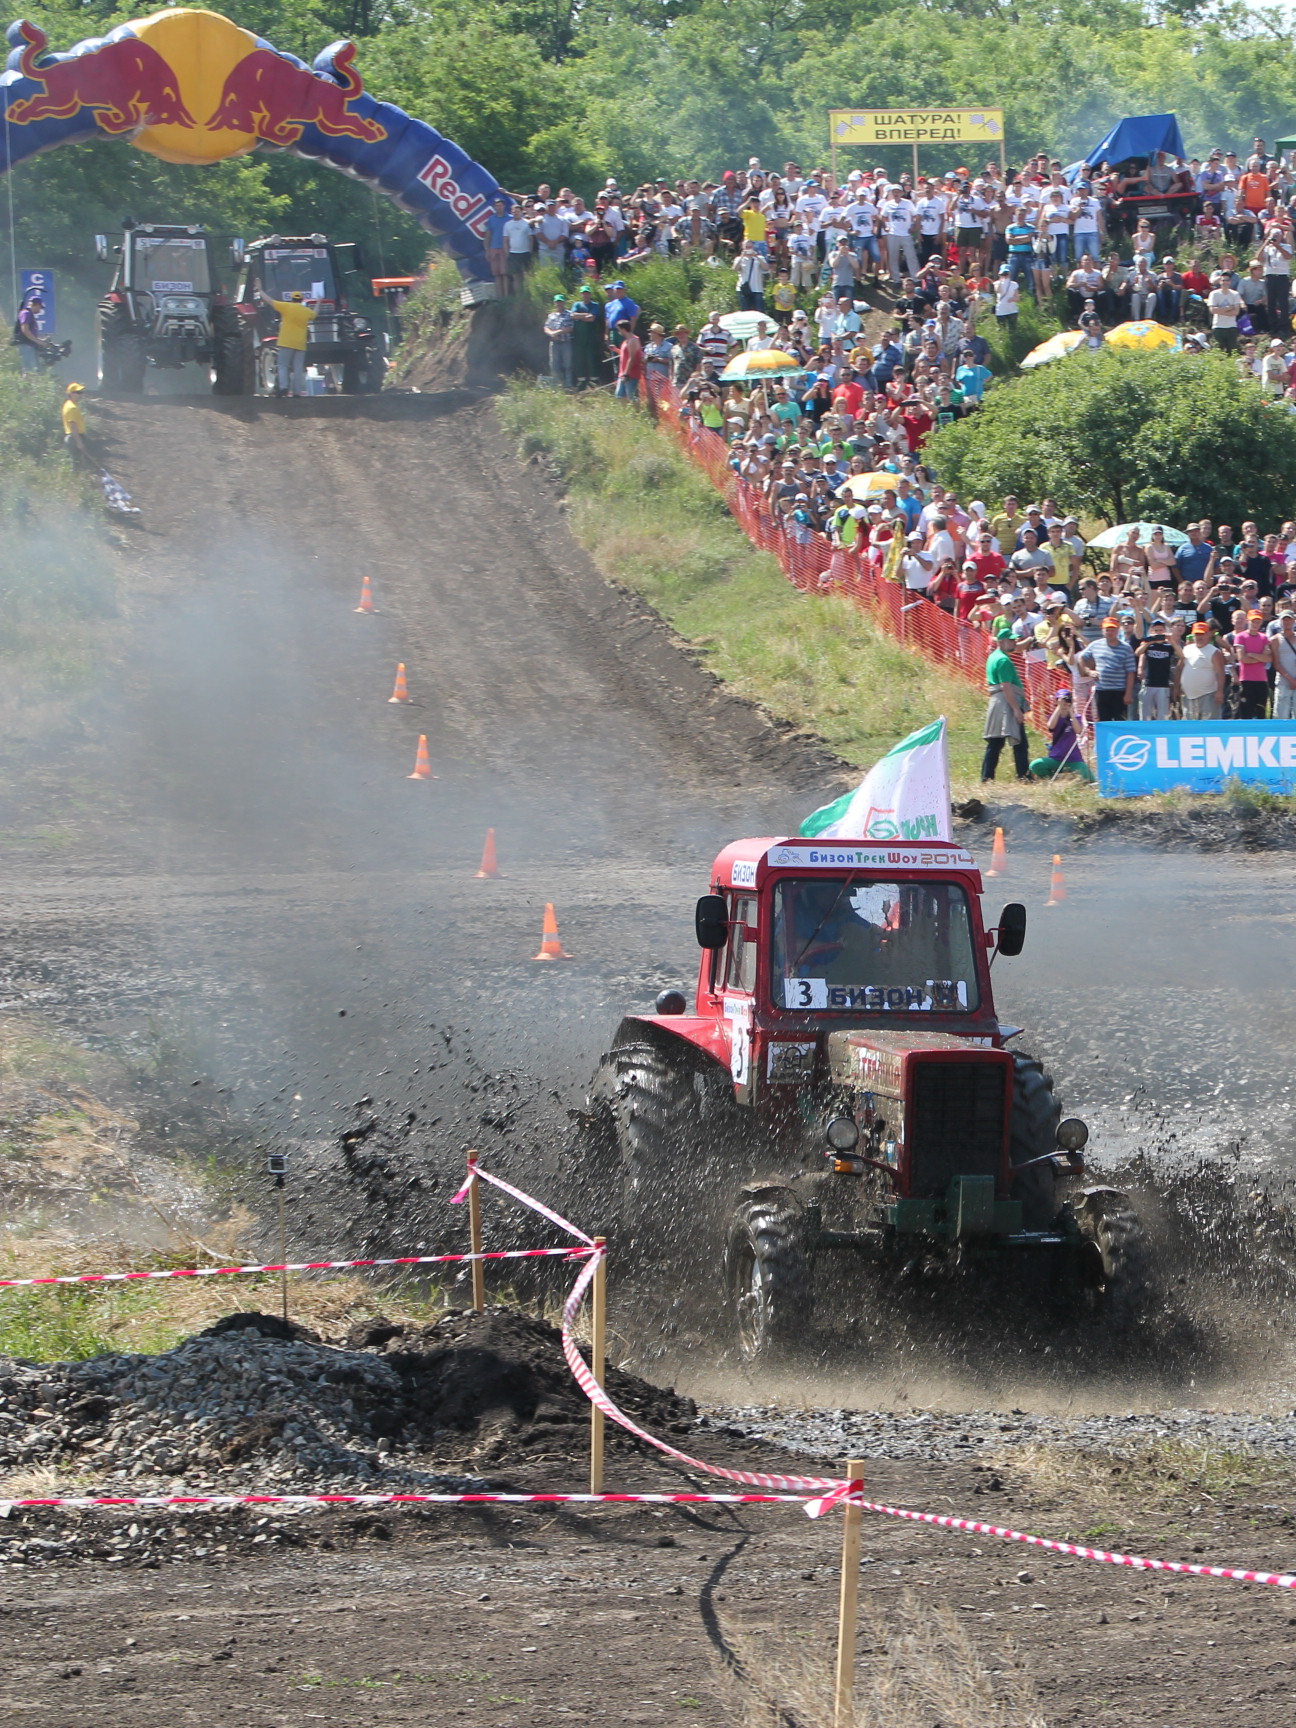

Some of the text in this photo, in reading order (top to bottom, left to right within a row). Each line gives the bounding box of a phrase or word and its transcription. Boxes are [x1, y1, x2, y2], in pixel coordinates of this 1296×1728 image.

[873, 114, 962, 126] ШАТУРА!
[874, 128, 962, 140] ВПЕРЕД!
[416, 154, 487, 221] Red
[154, 281, 193, 291] БИЗОН
[919, 852, 976, 866] 2014
[732, 863, 756, 882] БИЗОН
[798, 980, 812, 1007] 3
[830, 986, 924, 1008] БИЗОН
[735, 1026, 744, 1079] 3
